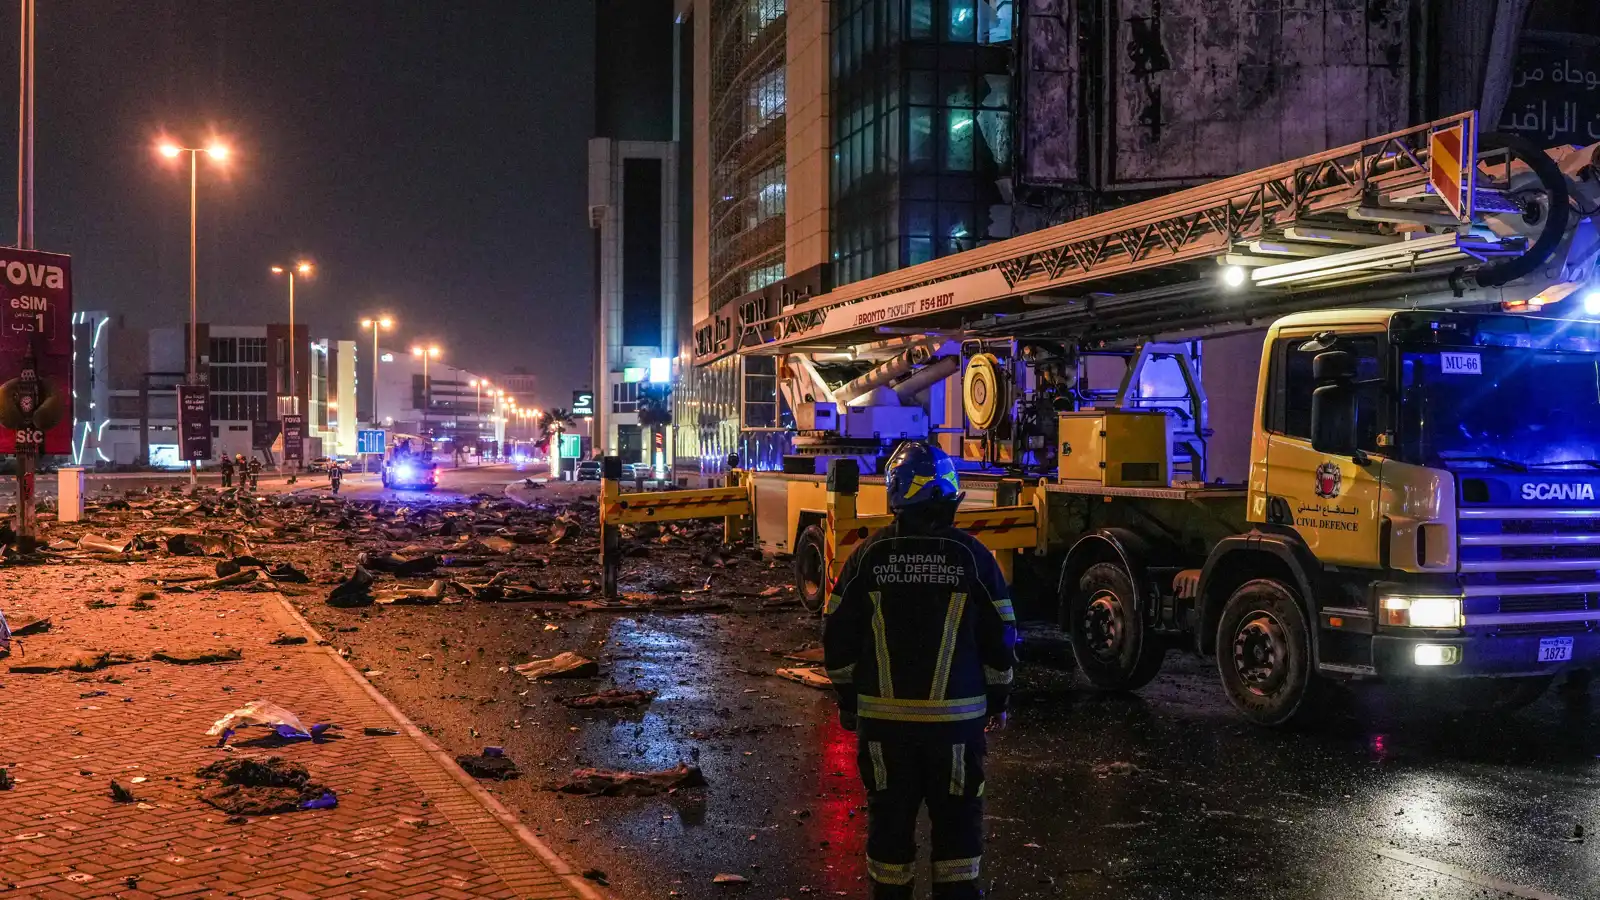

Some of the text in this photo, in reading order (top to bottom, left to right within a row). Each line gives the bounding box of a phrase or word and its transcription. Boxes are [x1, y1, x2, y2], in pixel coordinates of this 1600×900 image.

[1552, 59, 1600, 90] وحاة
[1498, 99, 1577, 140] الراقي
[10, 295, 48, 311] eSIM
[858, 308, 886, 325] BRONTO
[920, 296, 936, 310] F54
[936, 292, 955, 308] HDT
[35, 313, 44, 333] 1
[1445, 356, 1478, 370] MU-66
[574, 395, 592, 406] S
[16, 428, 44, 444] stc
[1521, 482, 1595, 500] SCANIA
[1296, 518, 1359, 532] CIVIL DEFENCE
[889, 554, 946, 564] BAHRAIN
[872, 564, 965, 576] CIVIL DEFENCE
[876, 574, 960, 586] (VOLUNTEER)
[1544, 647, 1566, 660] 1873
